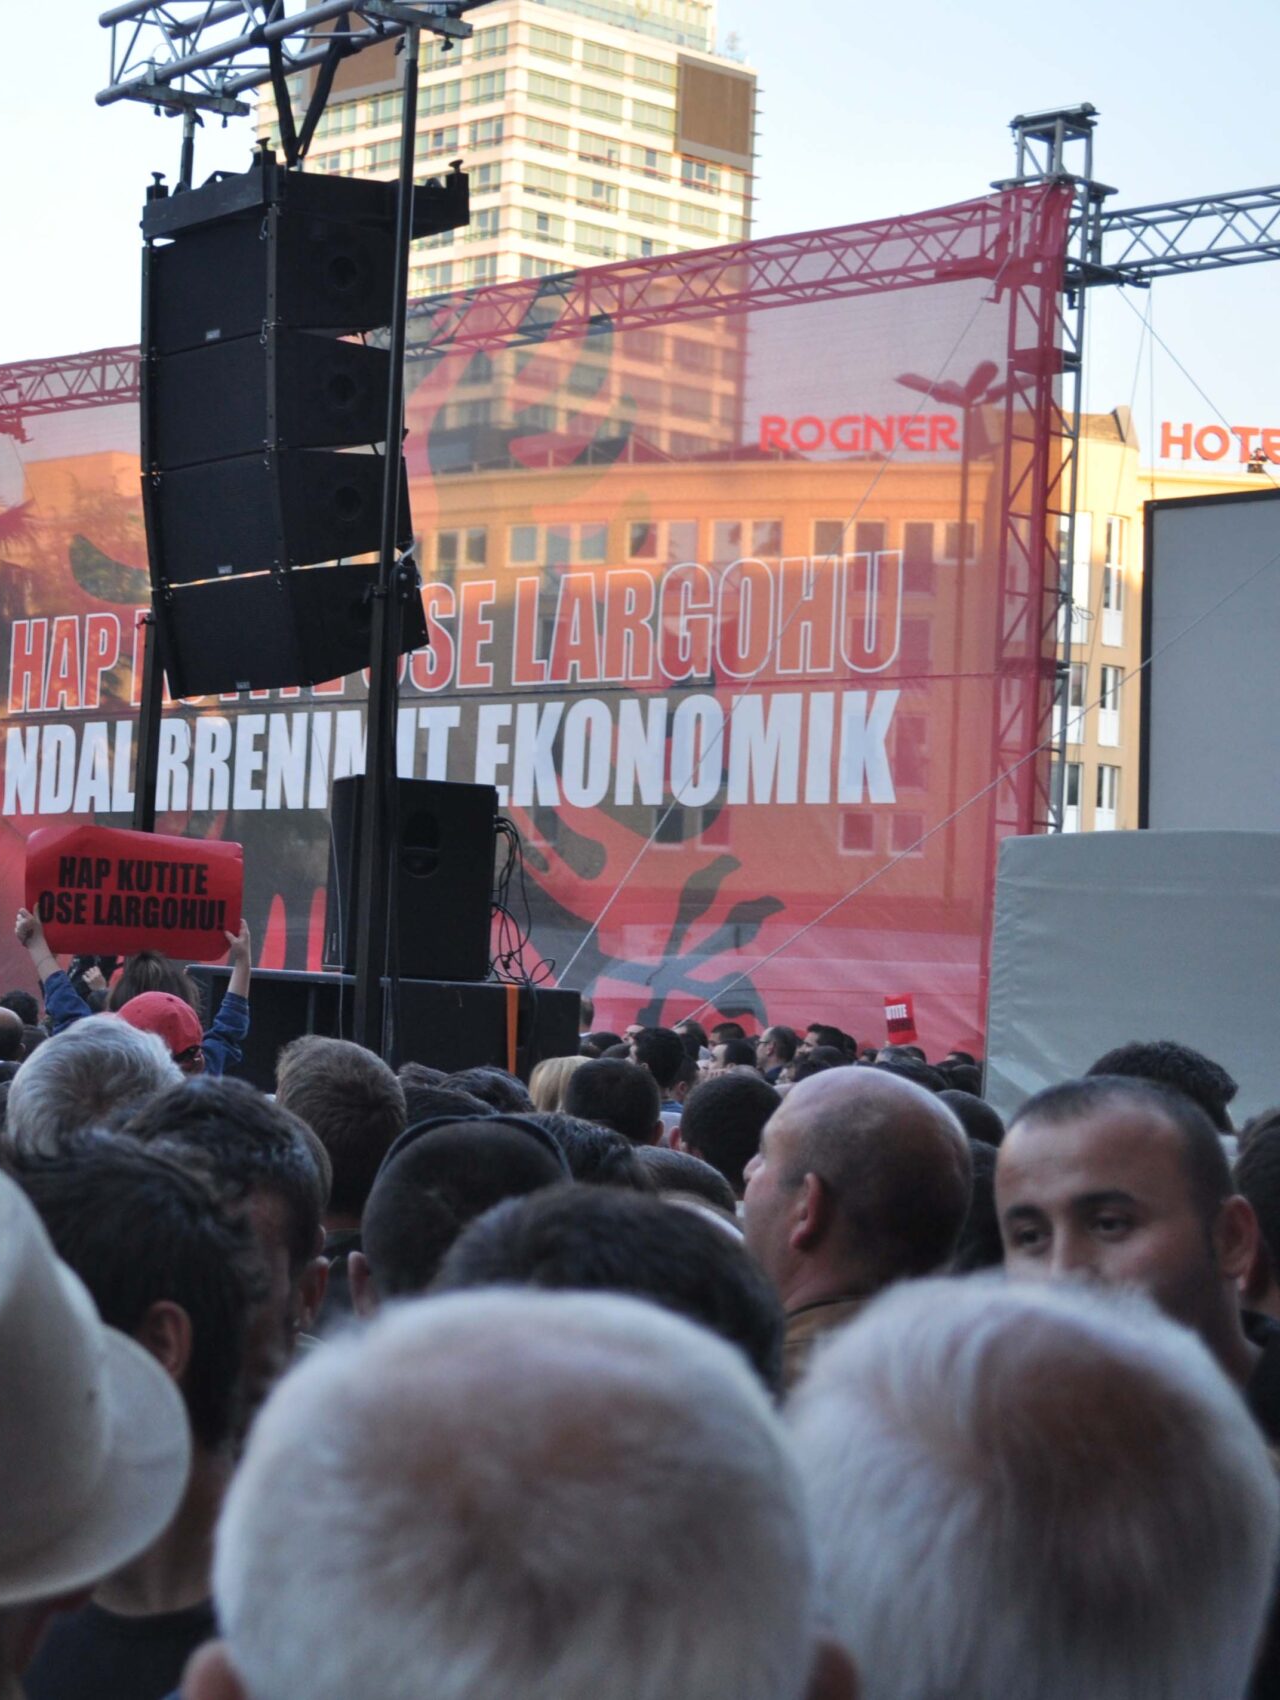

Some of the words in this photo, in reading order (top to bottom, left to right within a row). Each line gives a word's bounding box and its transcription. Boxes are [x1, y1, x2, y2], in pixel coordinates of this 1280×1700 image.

[759, 413, 960, 452] ROGNER
[8, 612, 120, 713] HAP
[361, 579, 496, 693] SE
[511, 549, 903, 686] LARGOHU
[2, 720, 136, 815] NDAL
[475, 689, 900, 809] EKONOMIK
[57, 855, 112, 890] HAP
[117, 858, 210, 896] KUTITE
[37, 890, 87, 925] OSE
[93, 895, 227, 931] LARGOHU!
